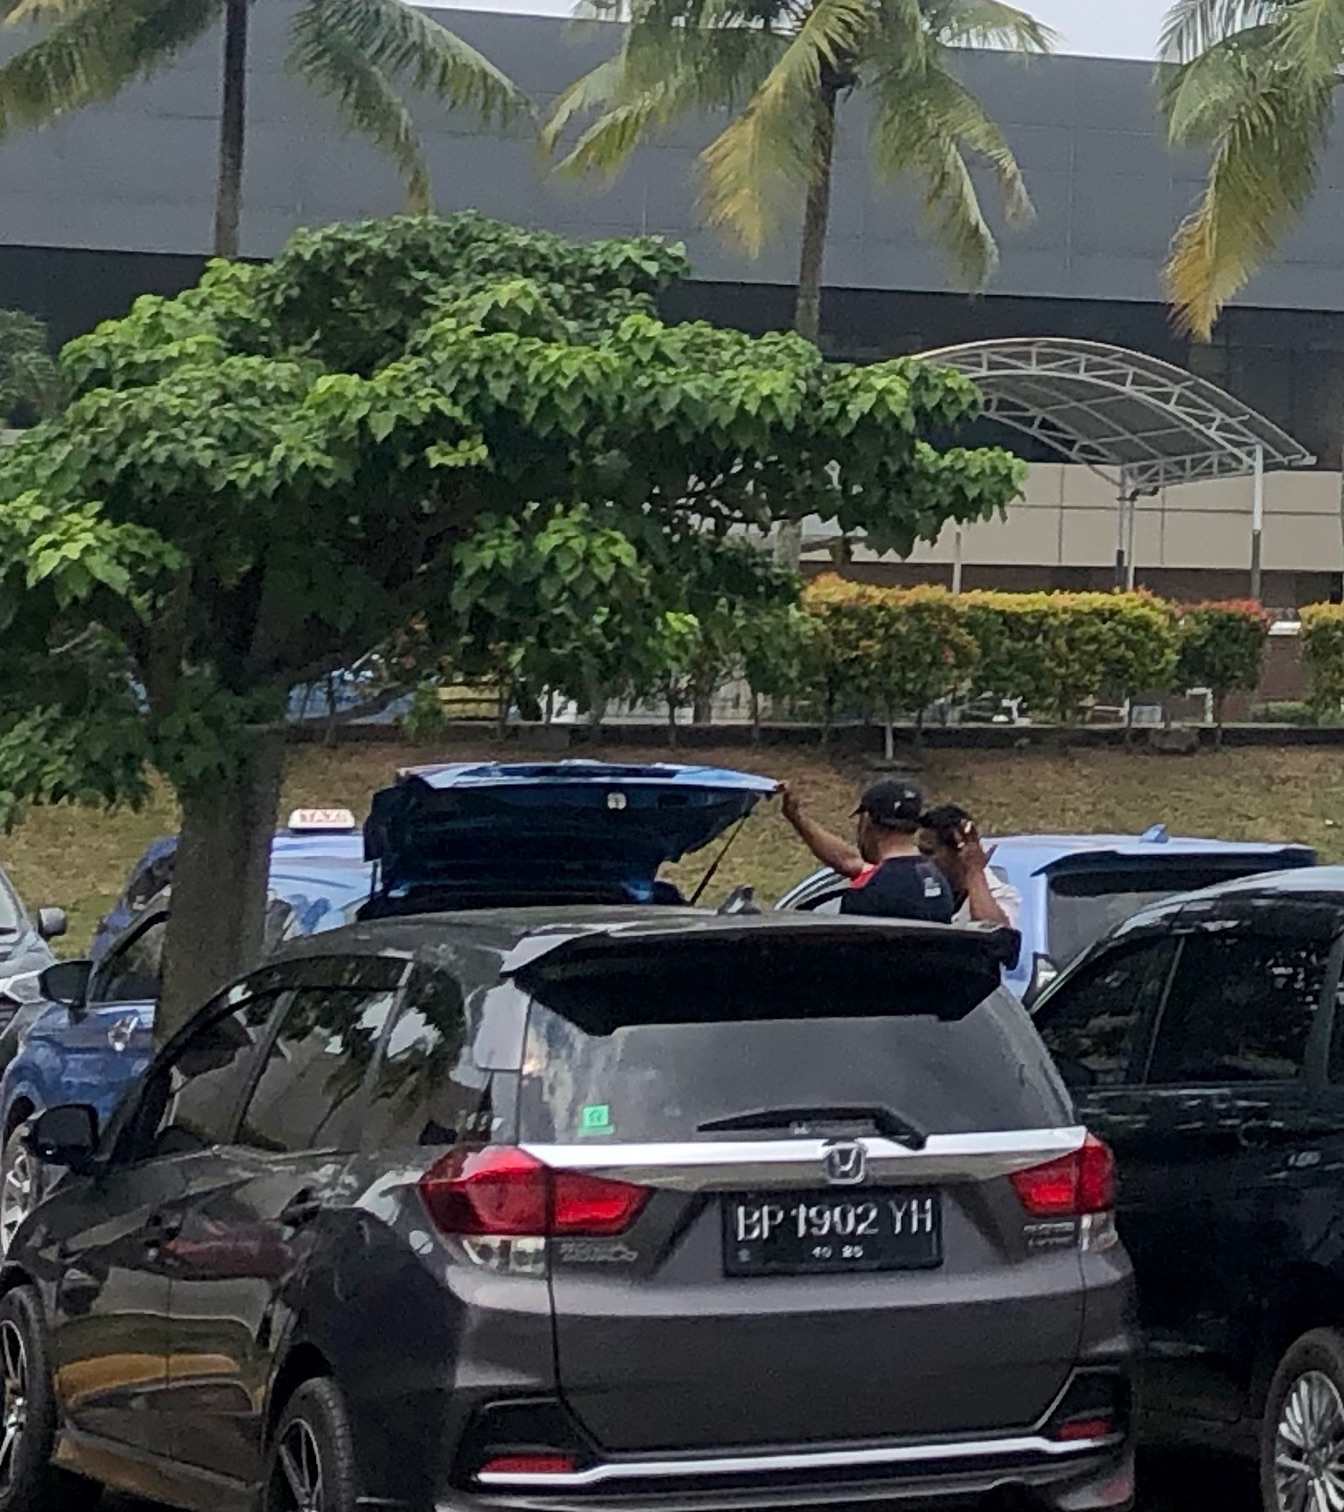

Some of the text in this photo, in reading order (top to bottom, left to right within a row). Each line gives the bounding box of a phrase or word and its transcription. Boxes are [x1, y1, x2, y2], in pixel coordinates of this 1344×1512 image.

[736, 1198, 933, 1241] BP 1902 YH
